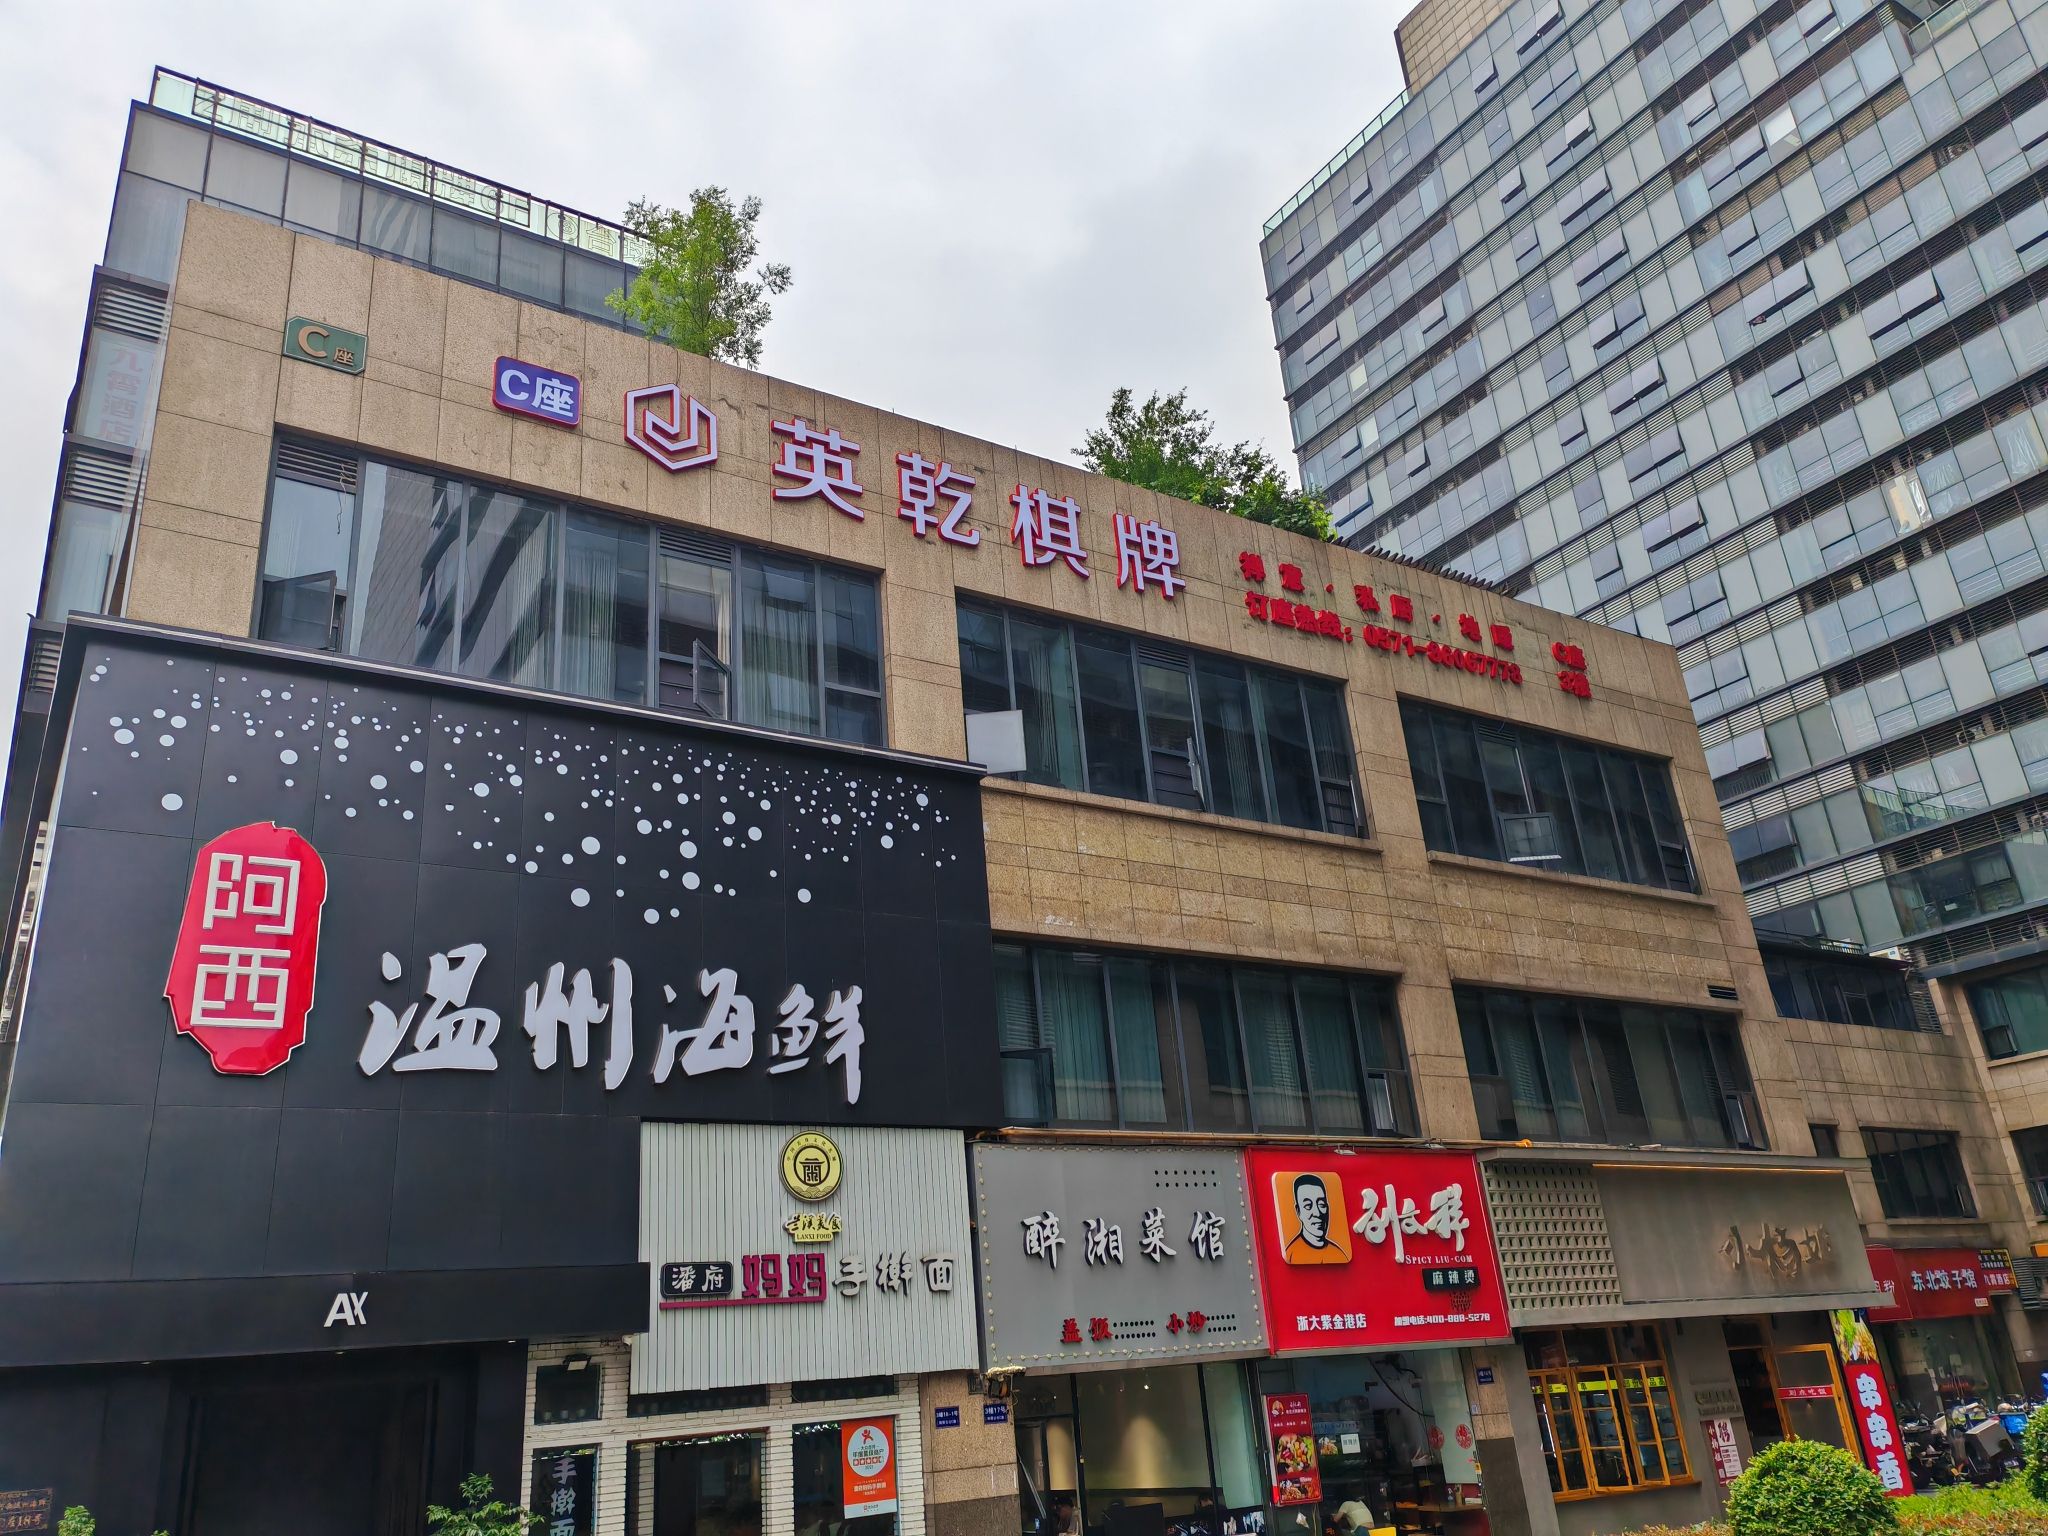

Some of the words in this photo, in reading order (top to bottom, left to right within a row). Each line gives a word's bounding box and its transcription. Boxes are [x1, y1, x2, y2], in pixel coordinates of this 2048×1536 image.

[297, 325, 355, 366] C座
[500, 368, 575, 417] C座
[771, 417, 1186, 600] 英乾棋牌
[189, 851, 299, 1029] 阿西
[356, 942, 866, 1105] 温州海鲜
[816, 1232, 832, 1240] FOOD
[1021, 1207, 1226, 1270] 醉湘菜馆
[1431, 1269, 1475, 1285] 麻辣烫
[1911, 1267, 1978, 1291] 东北饺子馆
[324, 1291, 369, 1327] AX
[1296, 1313, 1367, 1332] 浙大紫金港店
[1855, 1371, 1904, 1490] 串串香
